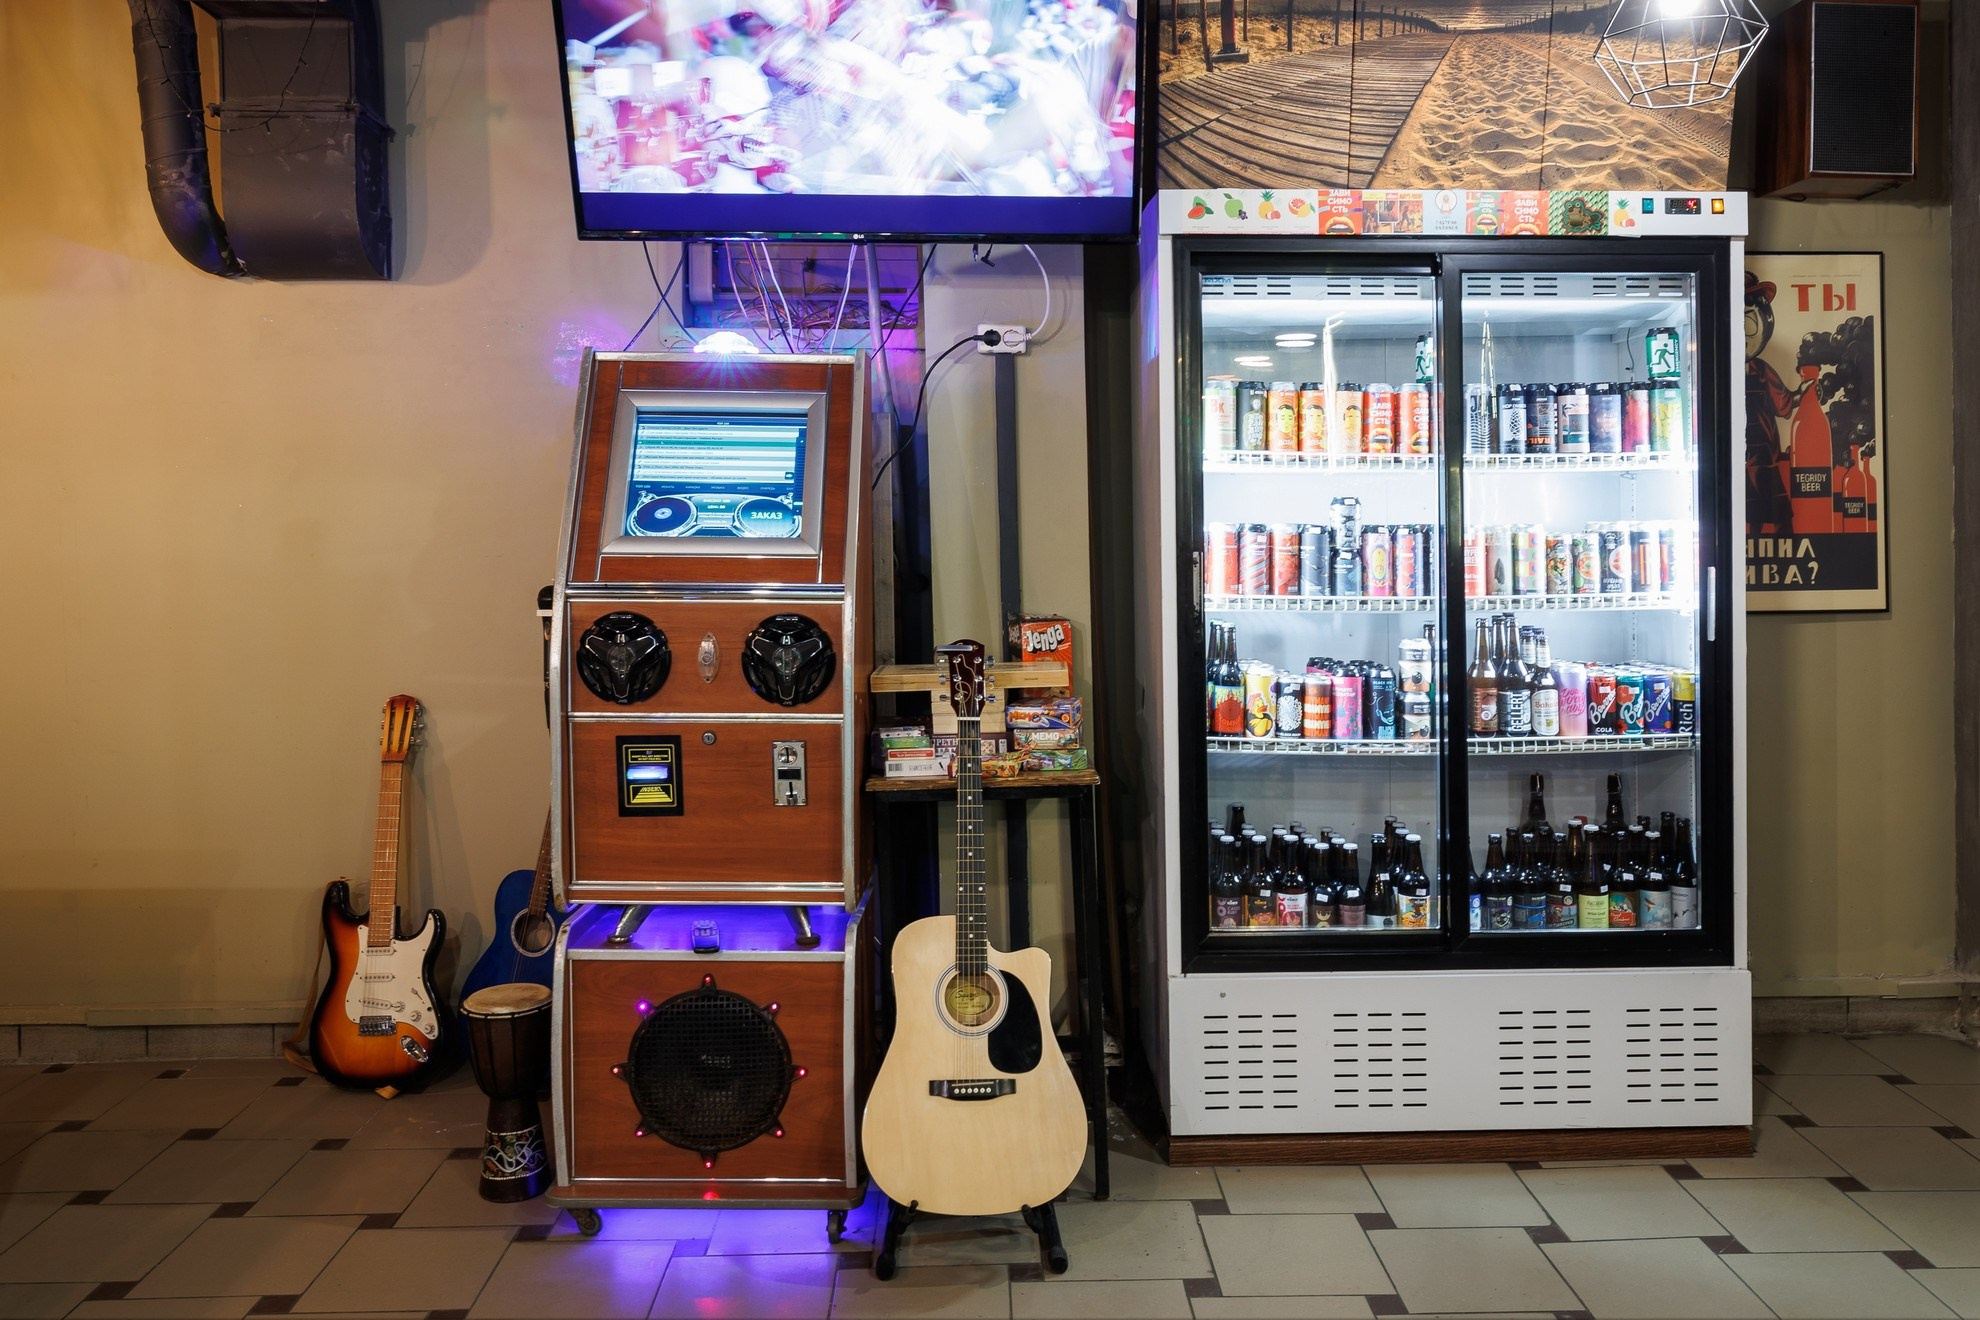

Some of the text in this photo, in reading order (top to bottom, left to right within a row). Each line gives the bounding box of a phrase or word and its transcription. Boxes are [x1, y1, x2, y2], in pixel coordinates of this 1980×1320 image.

[1514, 207, 1538, 215] СИМО
[1791, 283, 1857, 312] ТЫ
[1795, 473, 1827, 483] TEGRIDY
[1801, 481, 1821, 491] BEER
[1844, 501, 1864, 509] TEGRIDY
[1026, 624, 1064, 652] Jenga
[1511, 693, 1524, 731] GELLERT
[1679, 703, 1693, 734] Rich
[1032, 732, 1059, 740] MEMO
